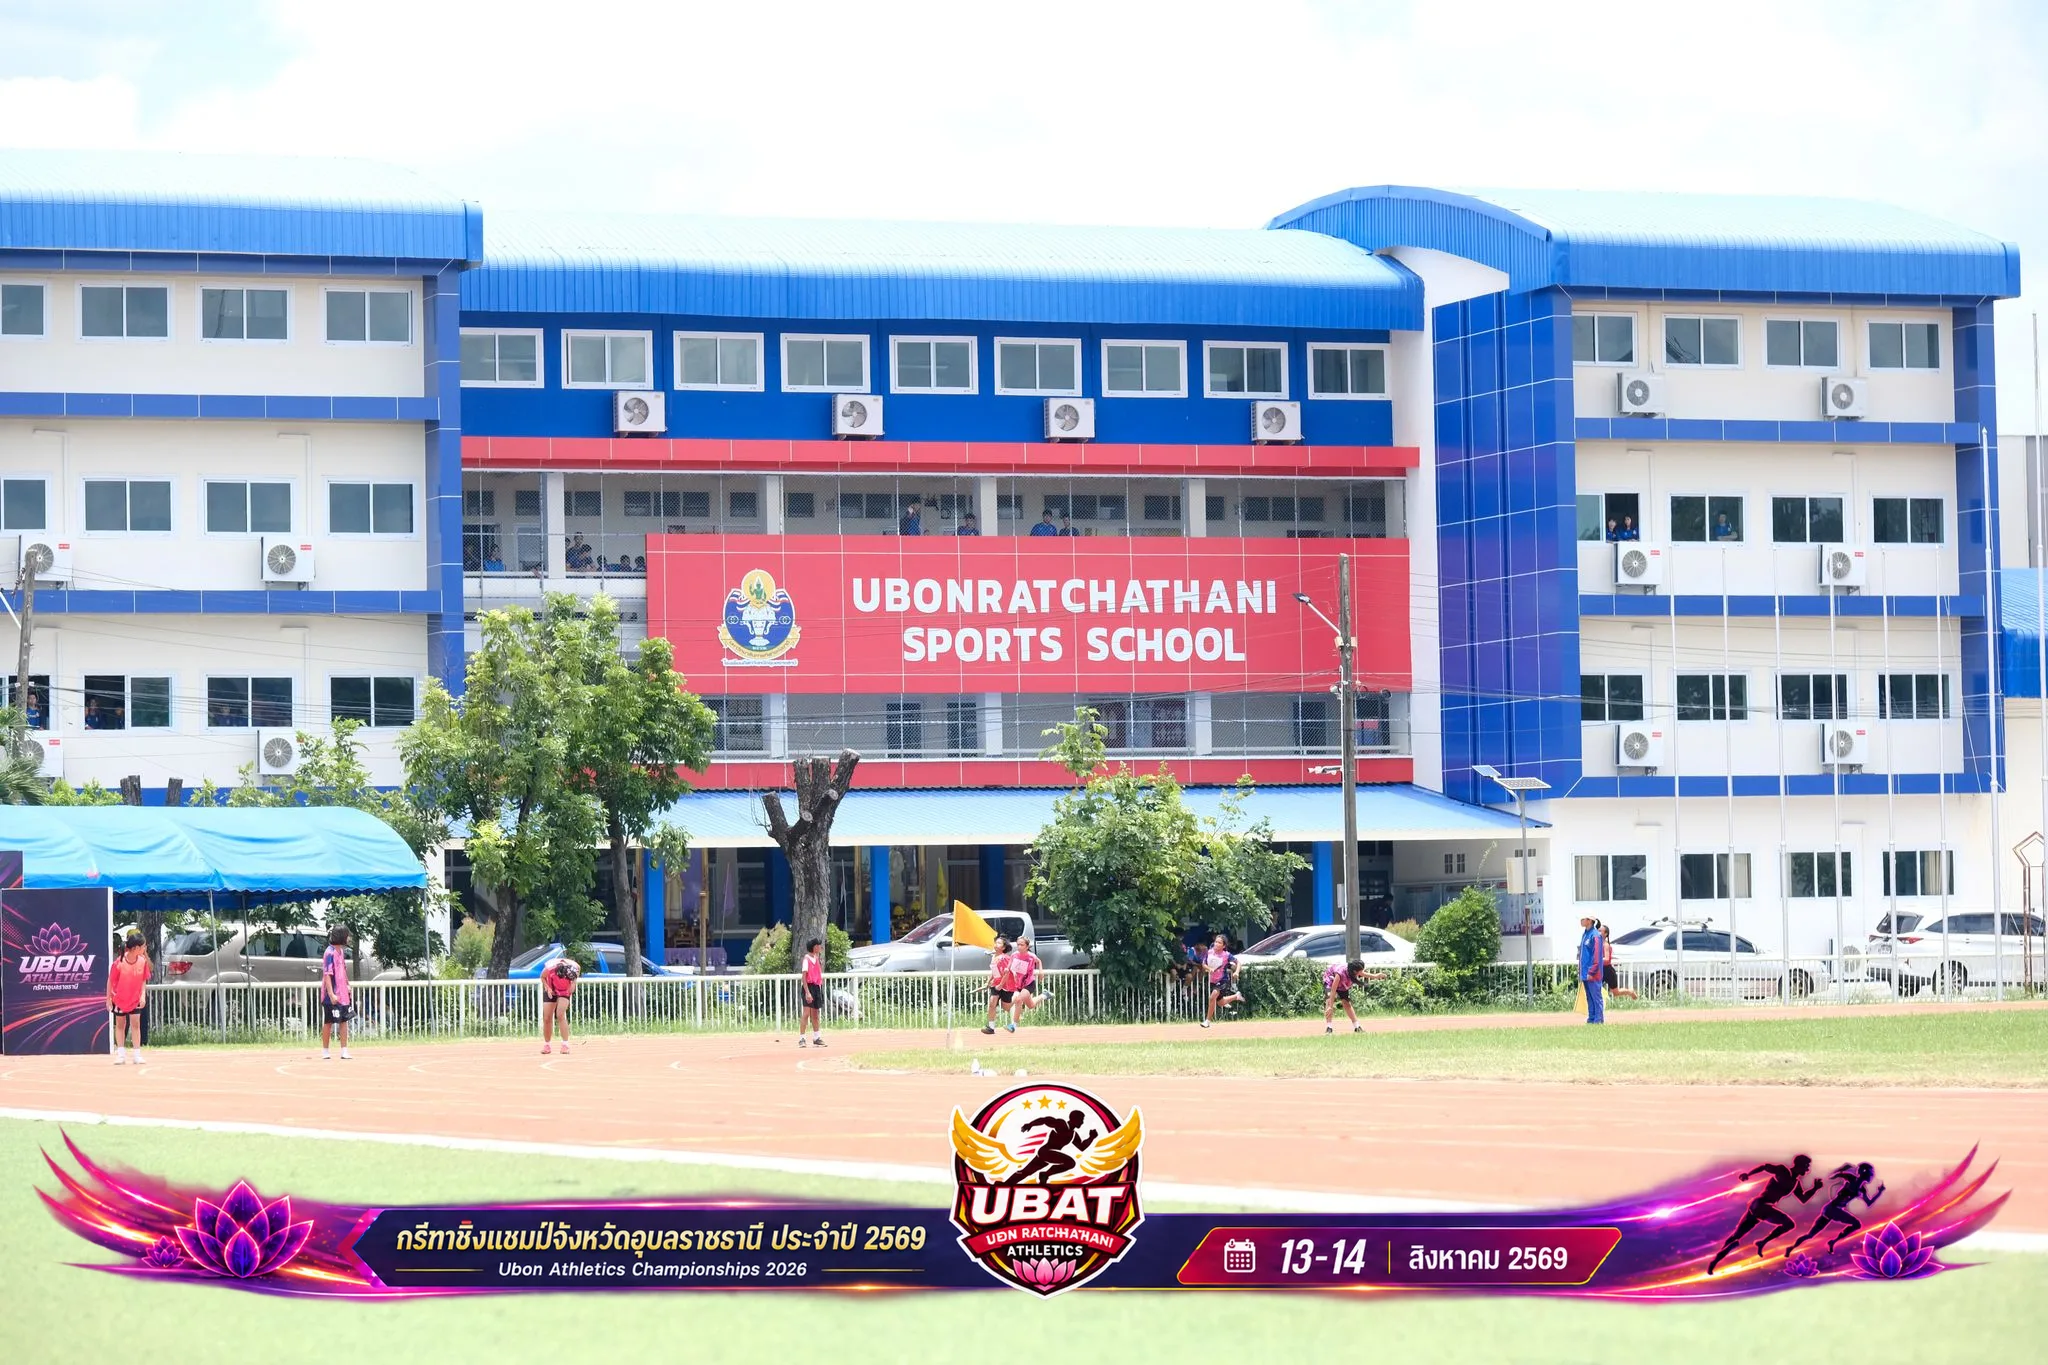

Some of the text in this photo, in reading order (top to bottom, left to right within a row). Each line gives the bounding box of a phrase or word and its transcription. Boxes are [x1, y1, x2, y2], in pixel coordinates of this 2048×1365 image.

[852, 577, 1277, 614] UBONRATCHATHANI
[903, 626, 1246, 662] SPORTS SCHOOL
[19, 955, 96, 973] UBON
[20, 972, 93, 983] ATHLETICS
